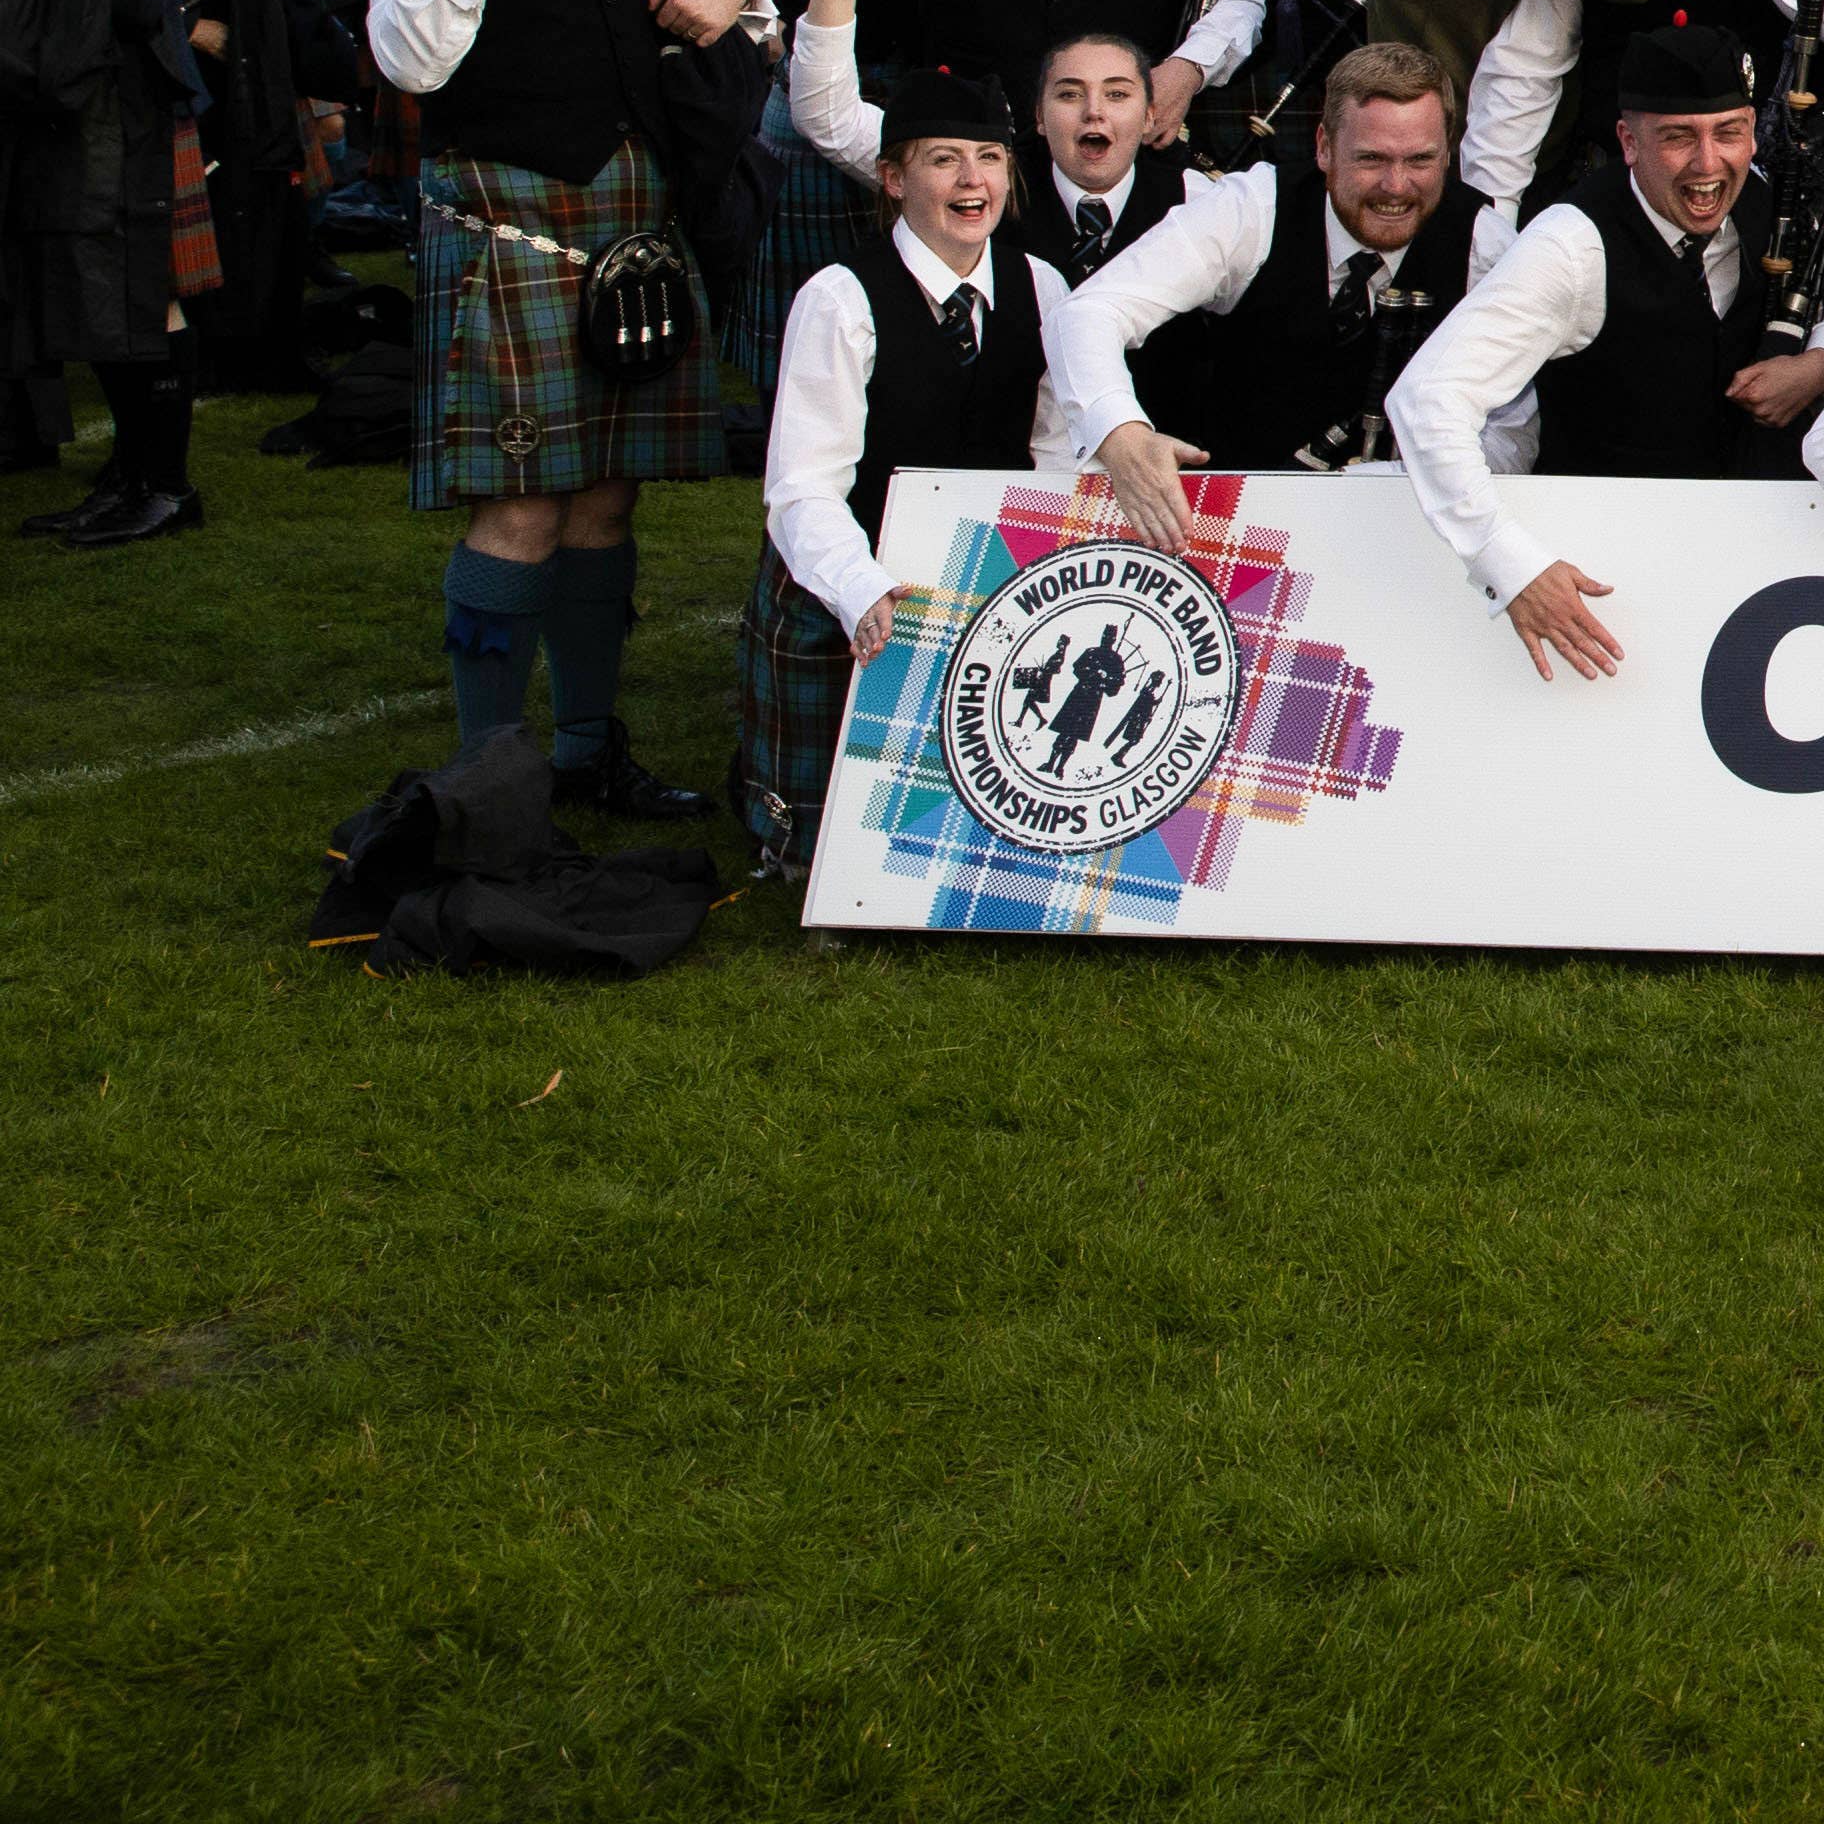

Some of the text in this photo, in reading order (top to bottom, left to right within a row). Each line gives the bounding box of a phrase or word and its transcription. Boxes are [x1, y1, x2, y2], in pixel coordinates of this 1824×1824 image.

[1013, 559, 1222, 676] WORLD PIPE BAND
[957, 662, 1207, 834] CHAMPIONSHIPS GLASGOW
